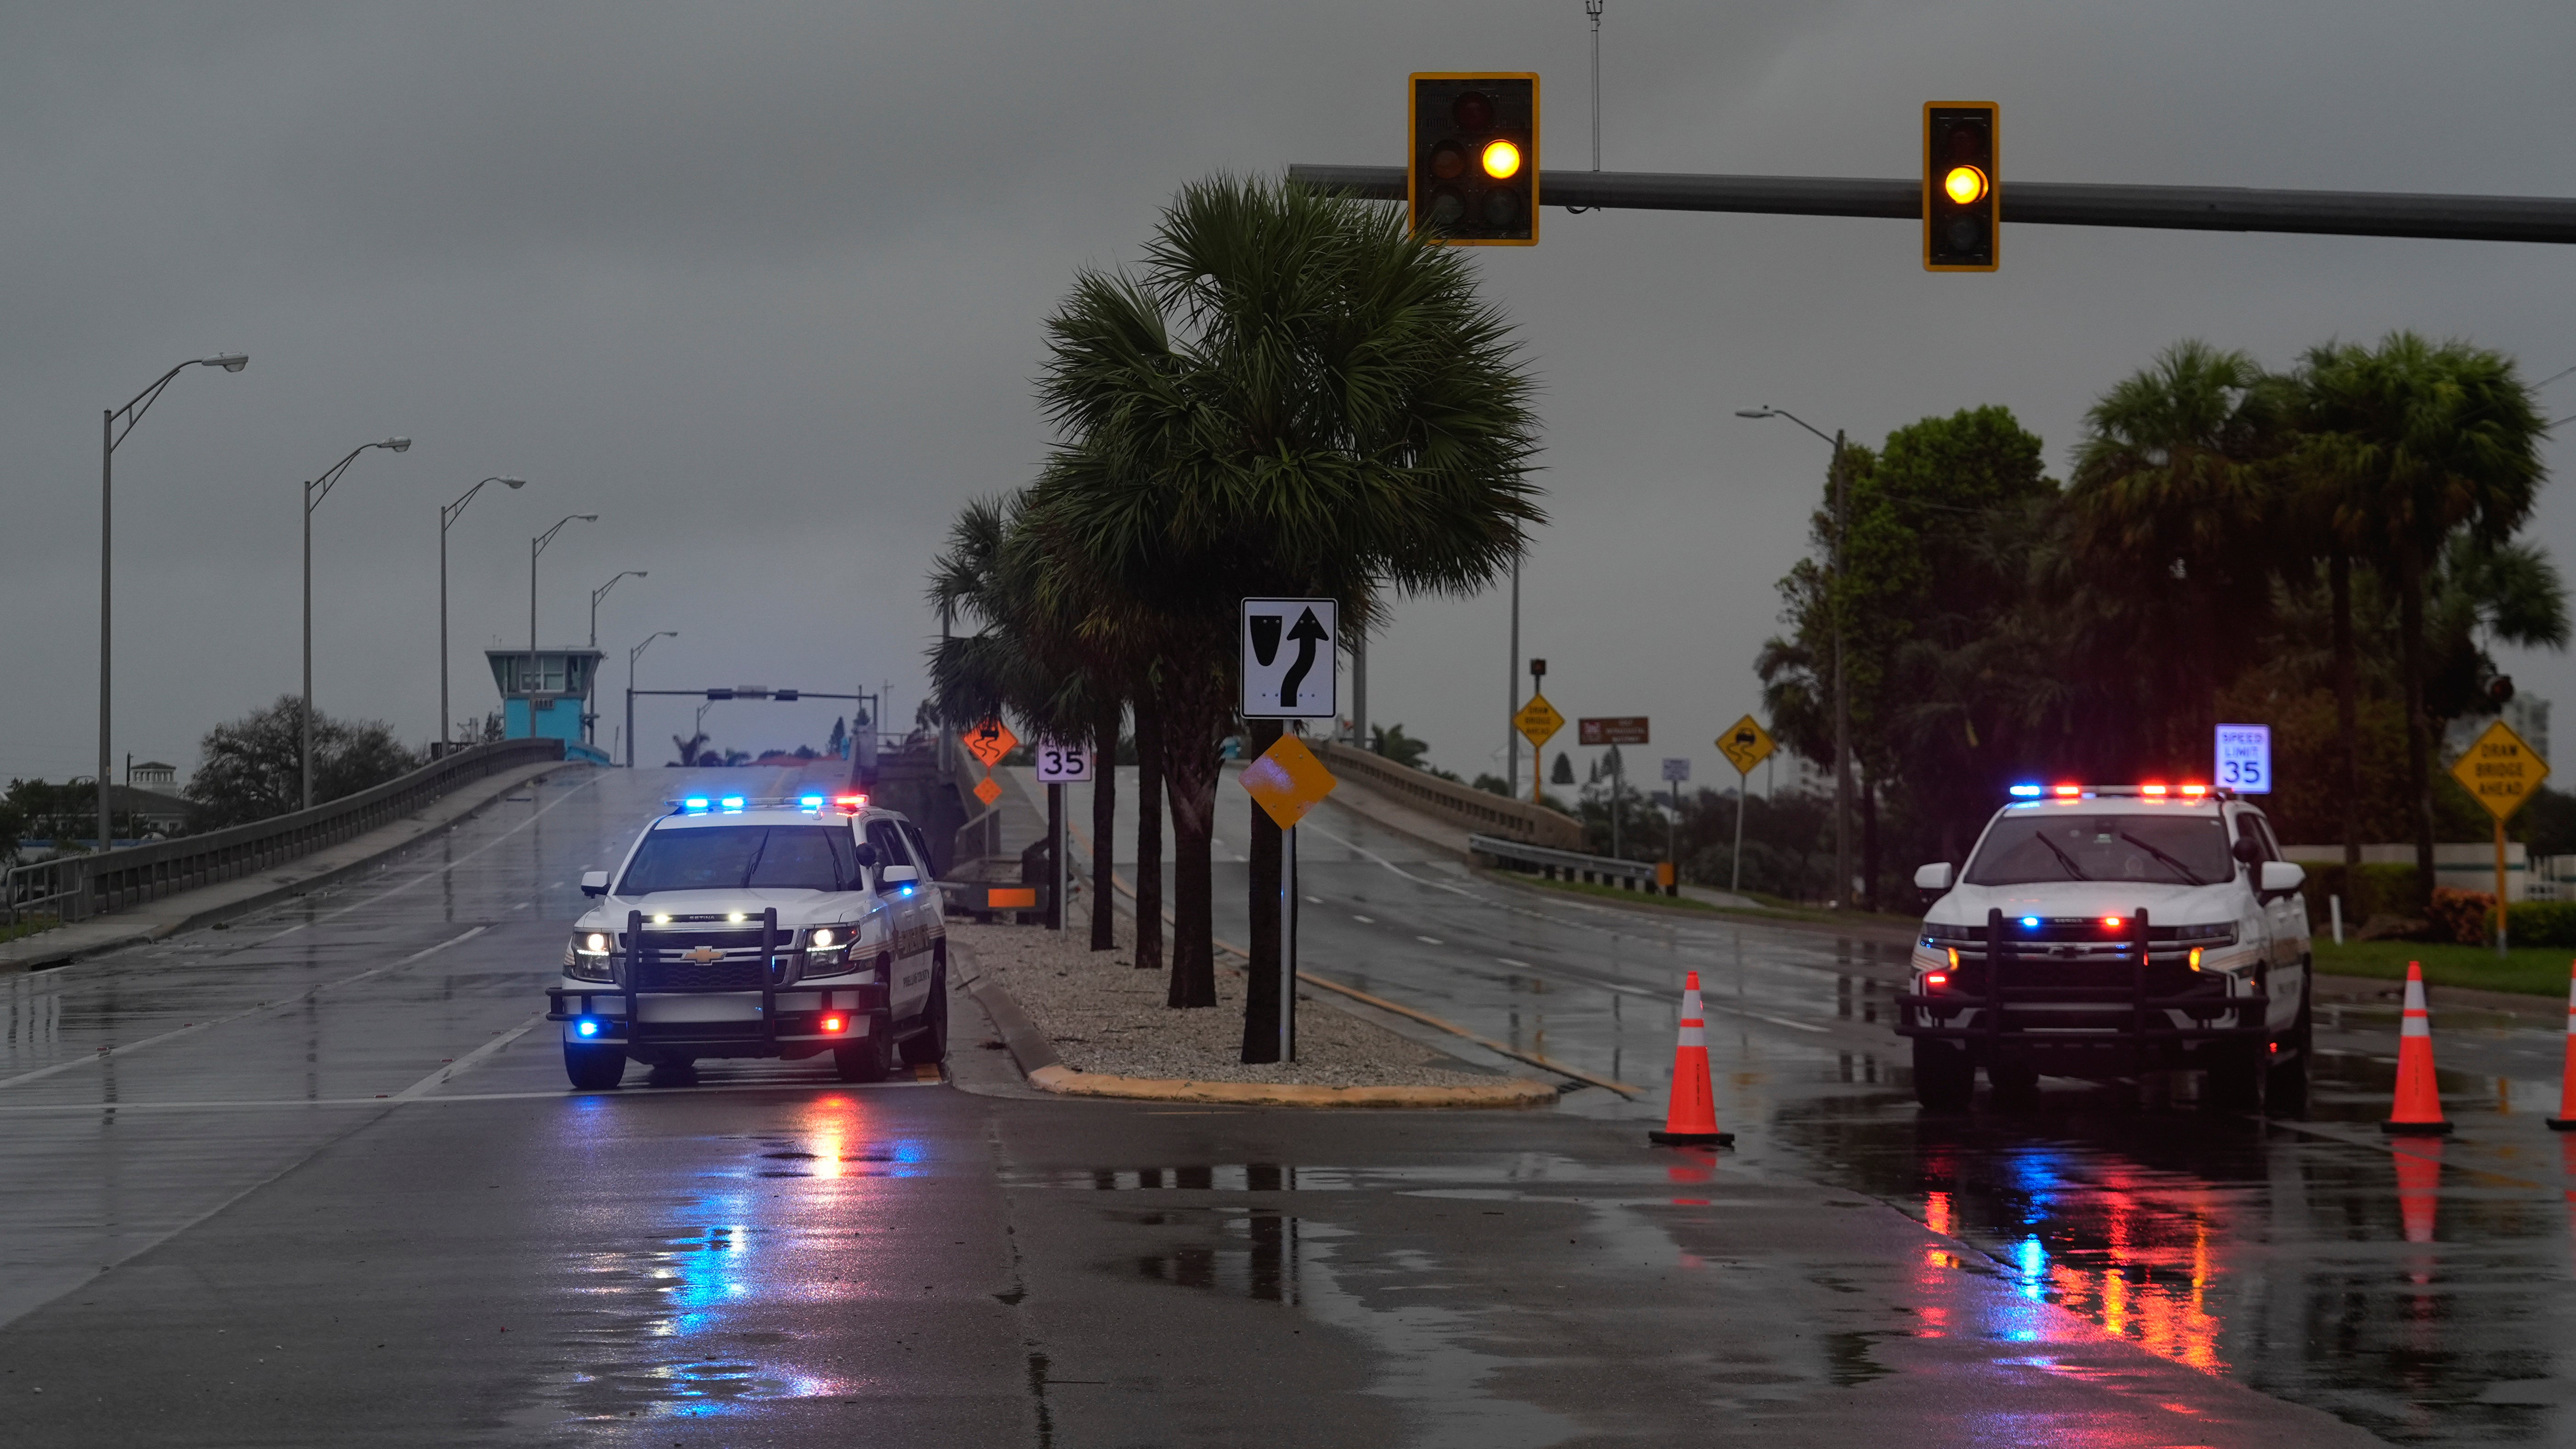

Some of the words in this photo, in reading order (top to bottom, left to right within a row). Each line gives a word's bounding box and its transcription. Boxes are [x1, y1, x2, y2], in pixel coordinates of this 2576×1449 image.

[2223, 733, 2262, 742] SPEED
[2225, 746, 2258, 756] LIMIT
[2481, 743, 2518, 757] DRAW
[1045, 752, 1084, 774] 35
[2475, 763, 2523, 777] BRIDGE
[2224, 761, 2260, 783] 35
[2479, 781, 2522, 795] AHEAD
